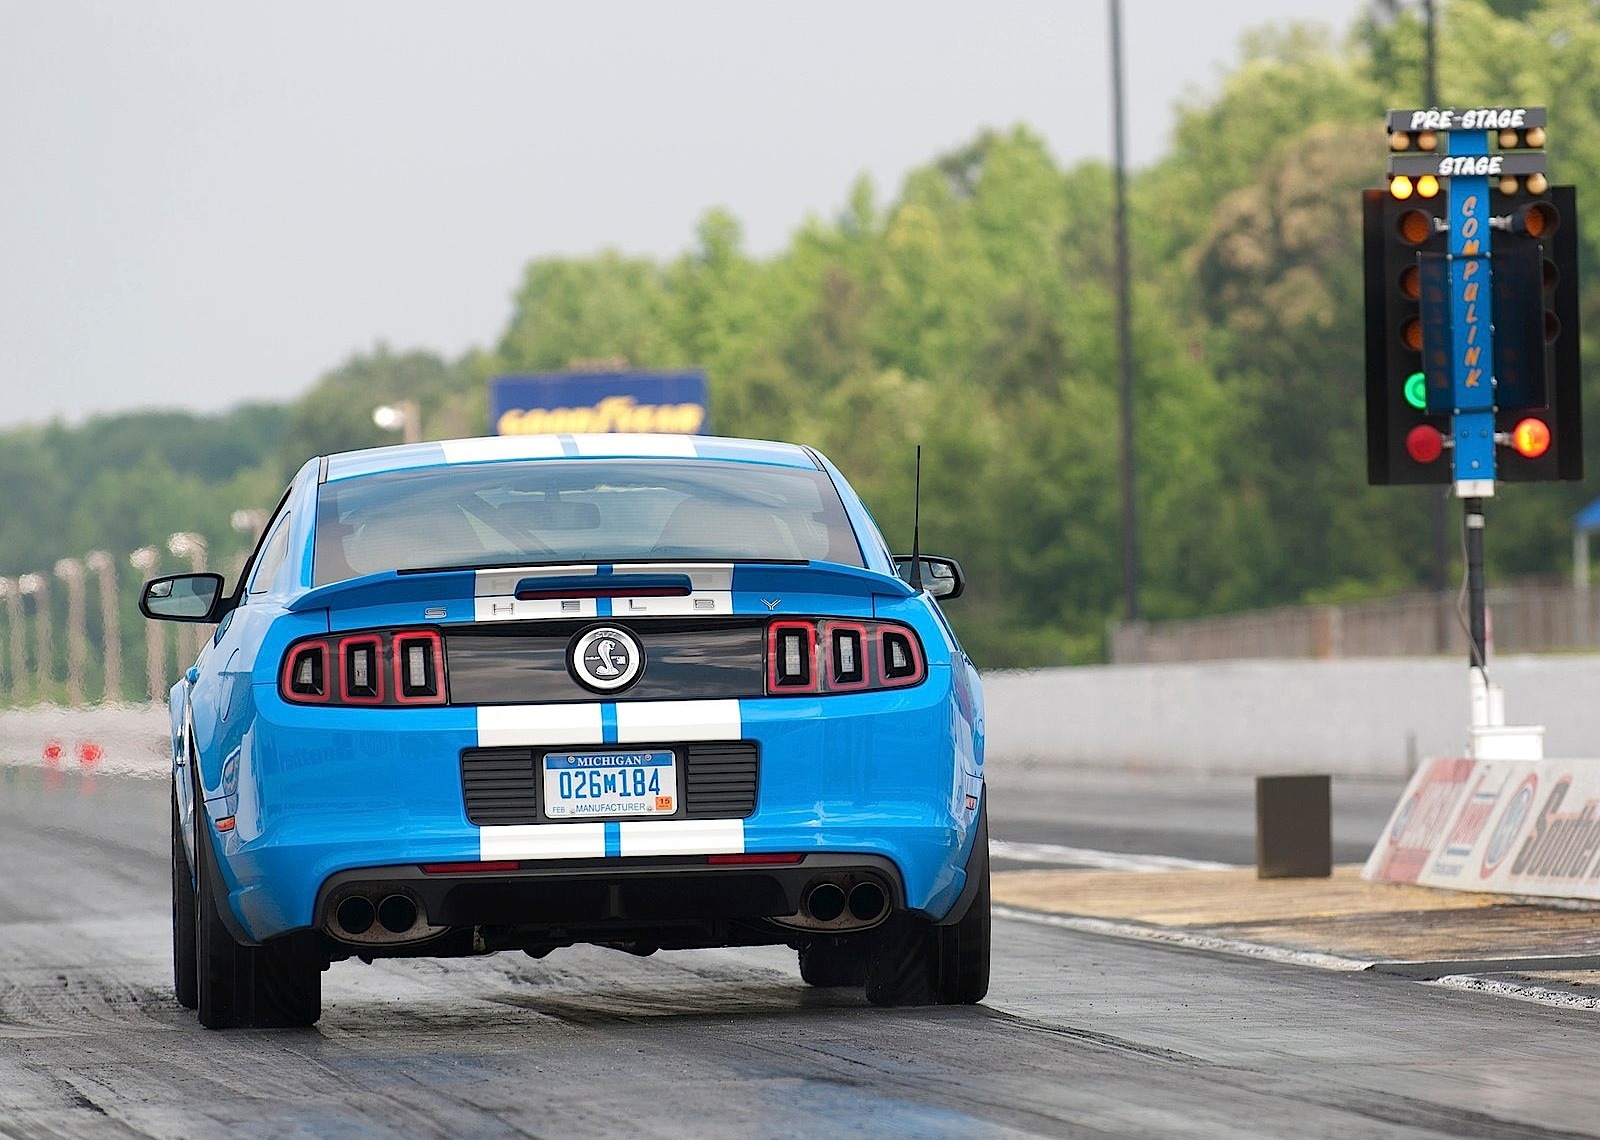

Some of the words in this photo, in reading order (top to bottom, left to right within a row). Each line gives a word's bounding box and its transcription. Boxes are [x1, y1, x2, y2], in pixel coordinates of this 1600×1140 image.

[1410, 109, 1526, 130] PRE-STAGE
[1438, 156, 1504, 176] STAGE
[1461, 195, 1483, 388] COMPULINK
[424, 598, 781, 619] SHELBY
[577, 755, 642, 767] MICHIGAN
[559, 768, 660, 799] 026M184
[552, 806, 565, 814] FEB
[575, 803, 646, 813] MANUFACTURER
